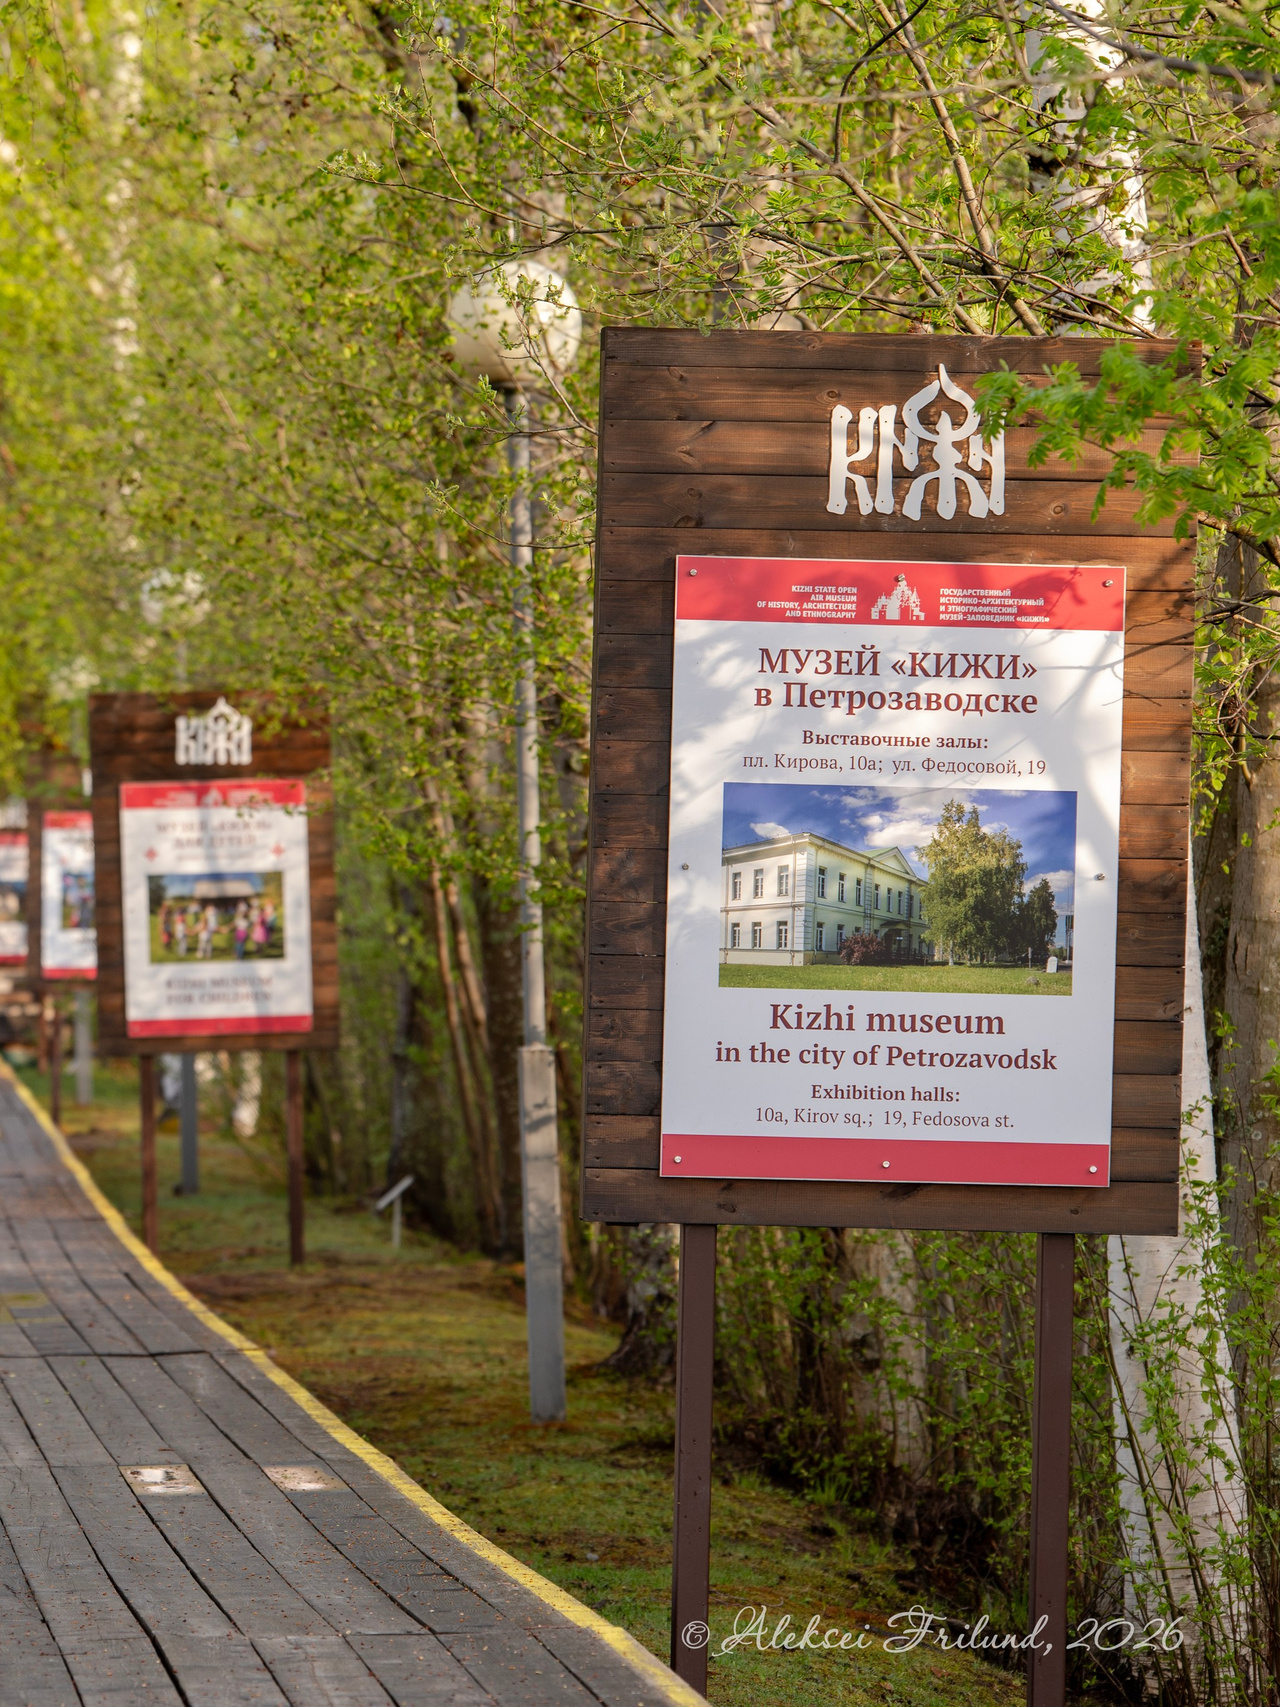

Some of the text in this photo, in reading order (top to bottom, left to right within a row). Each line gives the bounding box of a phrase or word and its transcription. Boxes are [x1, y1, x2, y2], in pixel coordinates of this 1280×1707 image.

[791, 585, 813, 593] KIZHI
[837, 586, 857, 594] OPEN
[940, 588, 1011, 596] ГОСУДАРСТВЕННЫЙ
[768, 601, 801, 610] HISTORY,
[802, 602, 857, 610] ARCHITECTURE
[940, 597, 1044, 606] ИСТОРИКО-АРХИТЕКТУРНЫЙ
[947, 605, 1018, 614] ЭТНОГРАФИЧЕСКИЙ
[939, 613, 1015, 623] МУЗЕЙ-ЗАПОВЕДНИК
[758, 644, 1038, 680] МУЗЕЙ «КИЖИ»
[754, 682, 1038, 717] в Петрозаводске
[802, 730, 989, 749] Выставочные залы:
[742, 753, 1046, 778] пл. Кирова, 10а; ул. Федосовой, 19
[770, 1003, 1006, 1035] Kizhi museum
[715, 1041, 1058, 1070] in the city of Petrozavodsk
[811, 1085, 960, 1103] Exhibition halls:
[755, 1107, 1014, 1128] 10a, Kirov sq.; 19, Fedosova st.
